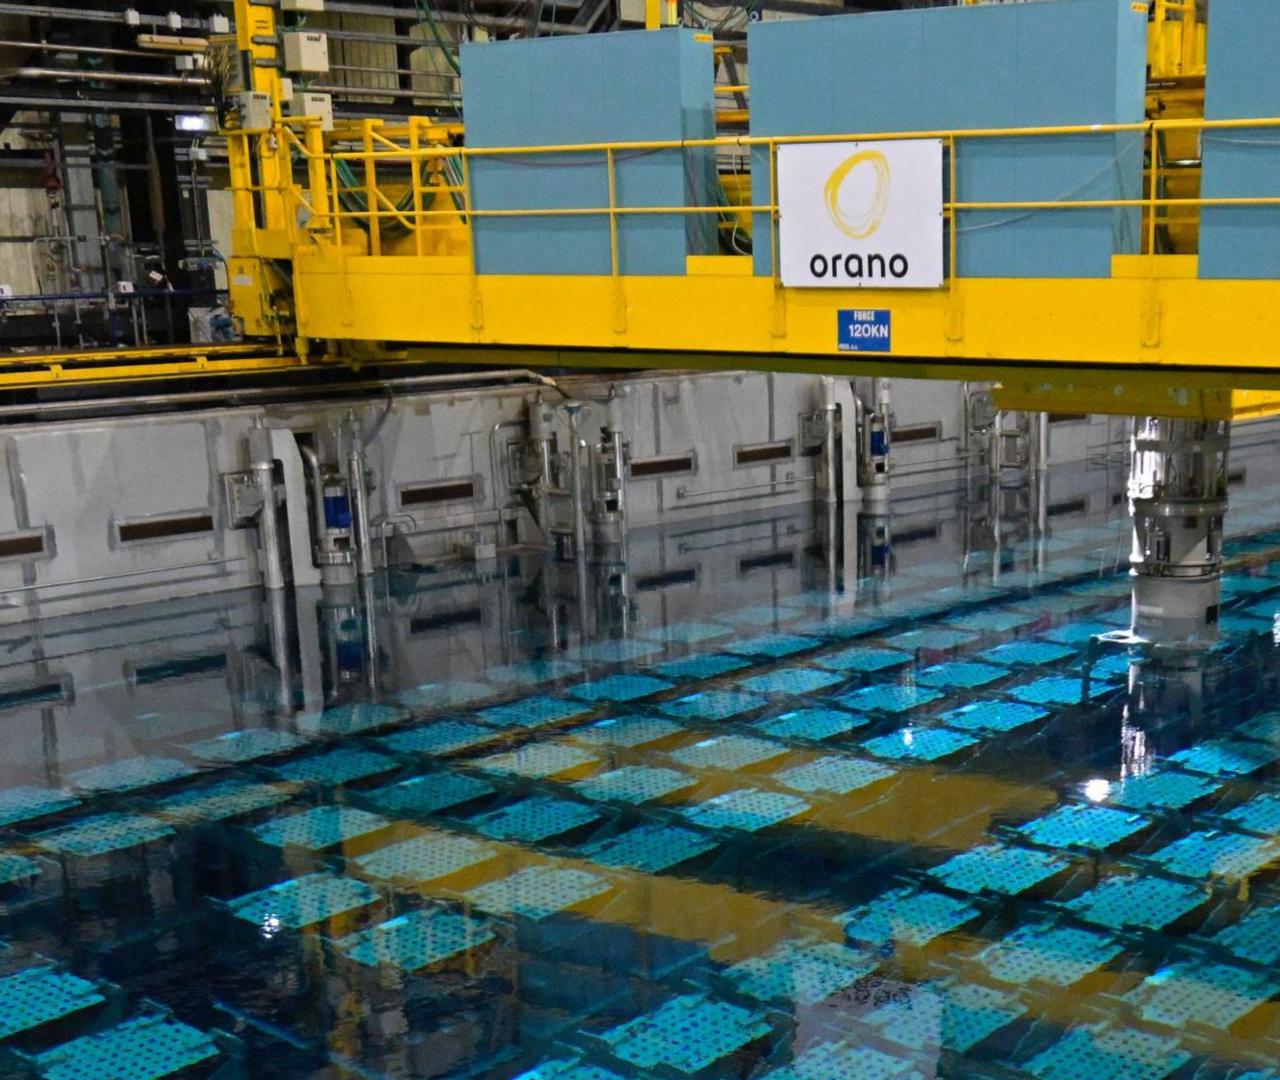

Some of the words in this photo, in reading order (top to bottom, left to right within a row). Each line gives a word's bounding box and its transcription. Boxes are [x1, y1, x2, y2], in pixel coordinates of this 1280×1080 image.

[810, 253, 908, 278] orano
[853, 310, 875, 321] FORCE
[848, 323, 889, 338] 120KN
